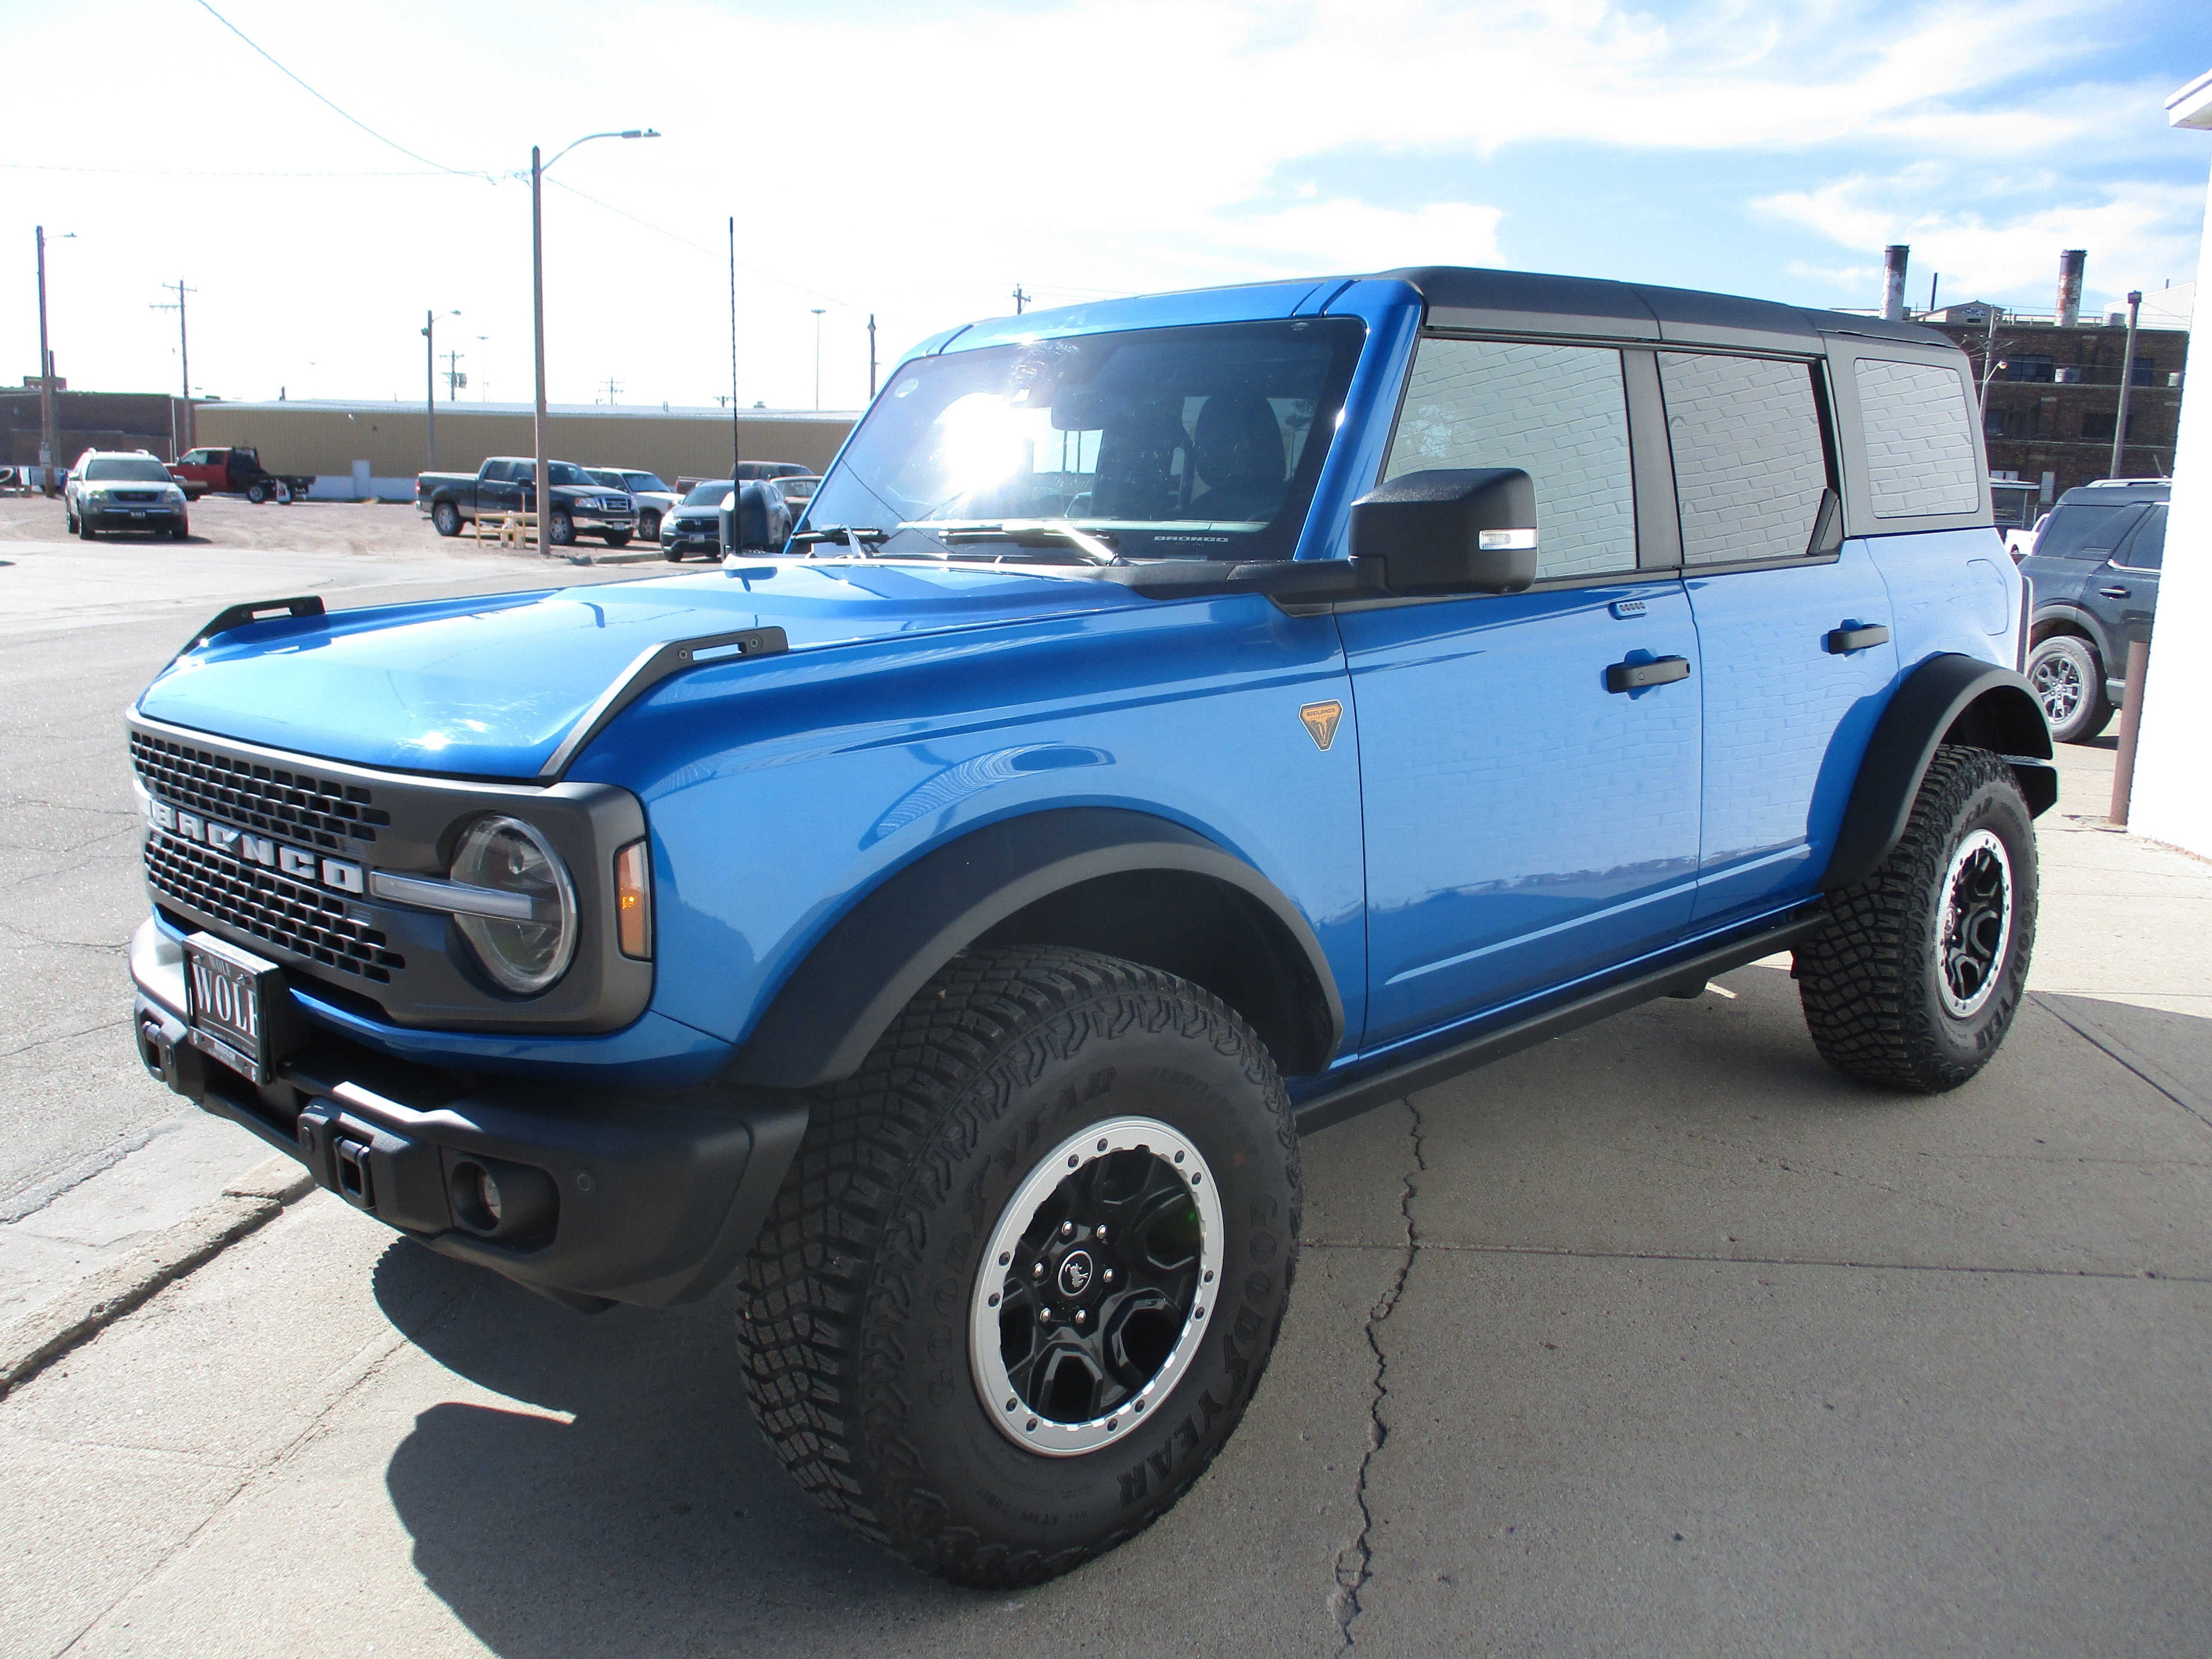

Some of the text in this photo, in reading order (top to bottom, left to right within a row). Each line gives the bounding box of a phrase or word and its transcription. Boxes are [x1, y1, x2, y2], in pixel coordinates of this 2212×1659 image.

[1307, 708, 1335, 717] BADLANDS
[151, 799, 364, 893] BRONCO
[191, 962, 258, 1039] WOLF
